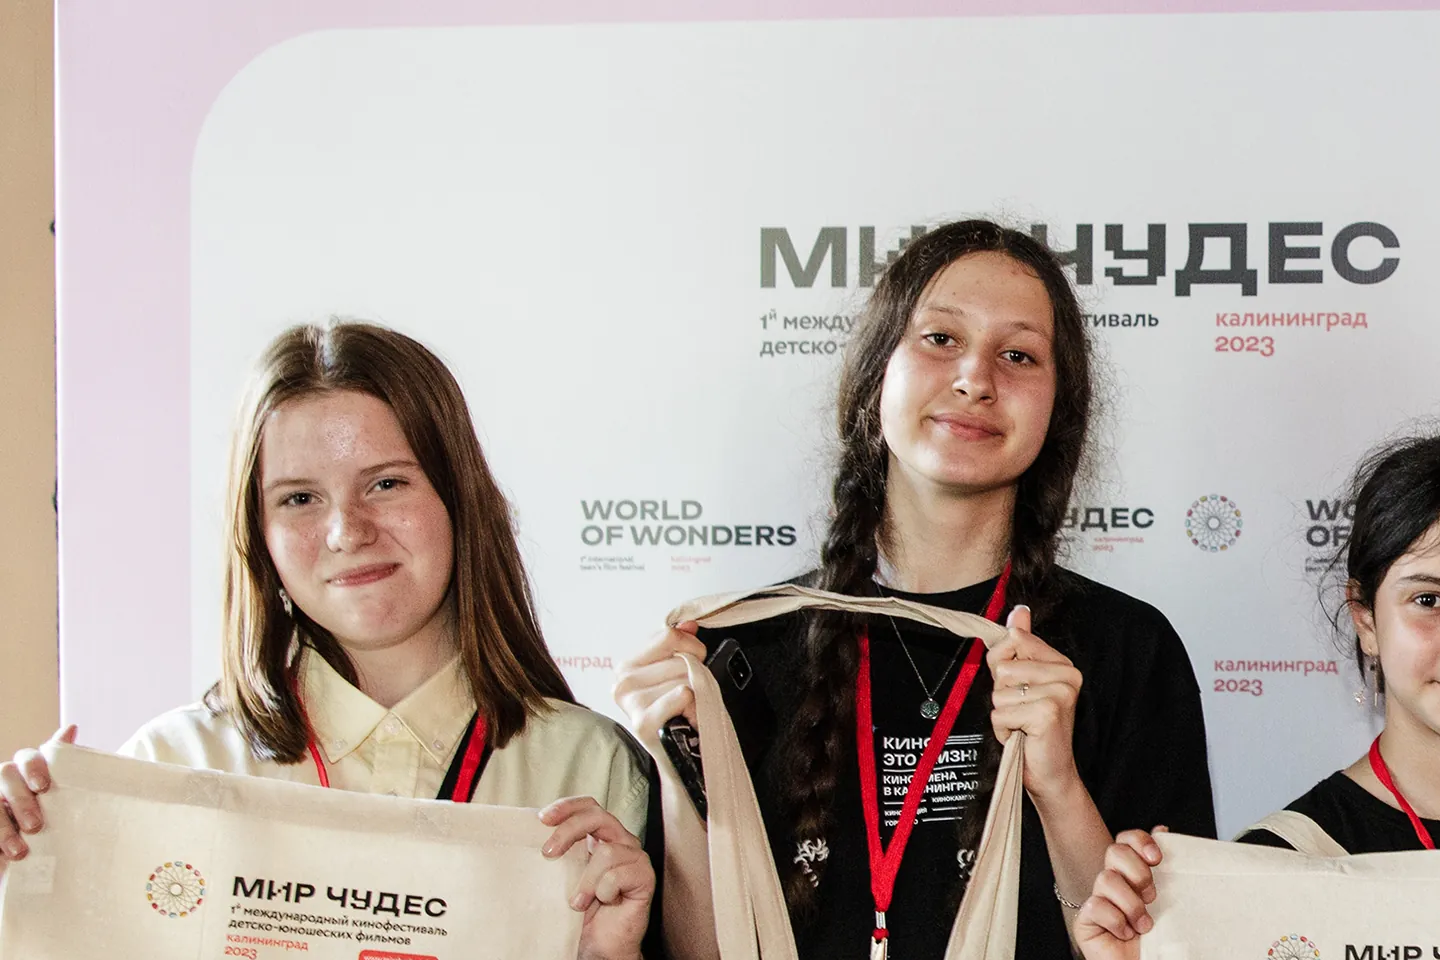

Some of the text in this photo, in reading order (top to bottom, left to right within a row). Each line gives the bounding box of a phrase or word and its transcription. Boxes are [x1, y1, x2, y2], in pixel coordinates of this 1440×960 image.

[760, 225, 927, 289] МИ
[1215, 310, 1368, 332] калининград
[1215, 336, 1275, 358] 2023
[580, 499, 703, 521] WORLD
[1062, 507, 1155, 532] УДЕС
[580, 525, 798, 547] OF WONDERS
[1306, 525, 1351, 547] OF
[1214, 658, 1339, 676] калининград
[1213, 679, 1264, 696] 2023
[883, 753, 917, 767] ЭТО
[883, 786, 892, 796] В
[232, 876, 448, 918] МИР ЧУДЕС
[228, 918, 411, 946] детско-юношеских фильмов
[243, 905, 349, 927] международный
[351, 915, 448, 937] кинофестиваль
[224, 946, 258, 960] 2023
[226, 933, 309, 952] калининград
